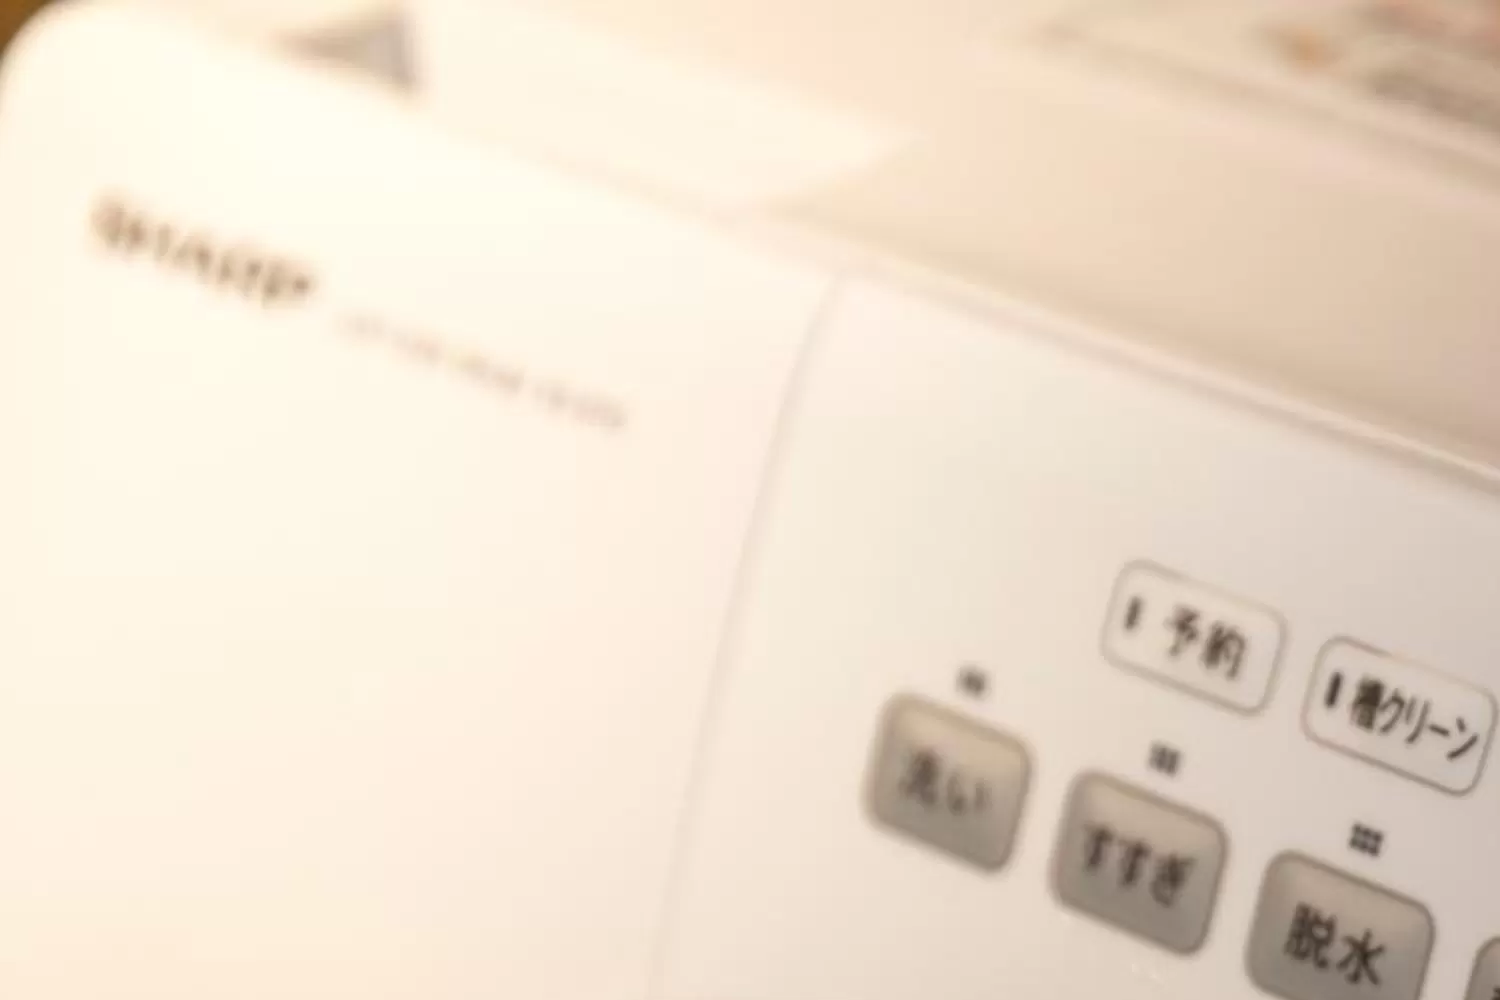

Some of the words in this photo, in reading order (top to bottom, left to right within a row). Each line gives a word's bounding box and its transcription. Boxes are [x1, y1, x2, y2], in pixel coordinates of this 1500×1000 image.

[1166, 602, 1247, 681] 予約
[1349, 676, 1480, 762] 槽クリーン
[1082, 821, 1198, 908] すすぎ
[1283, 900, 1386, 987] 脱水
